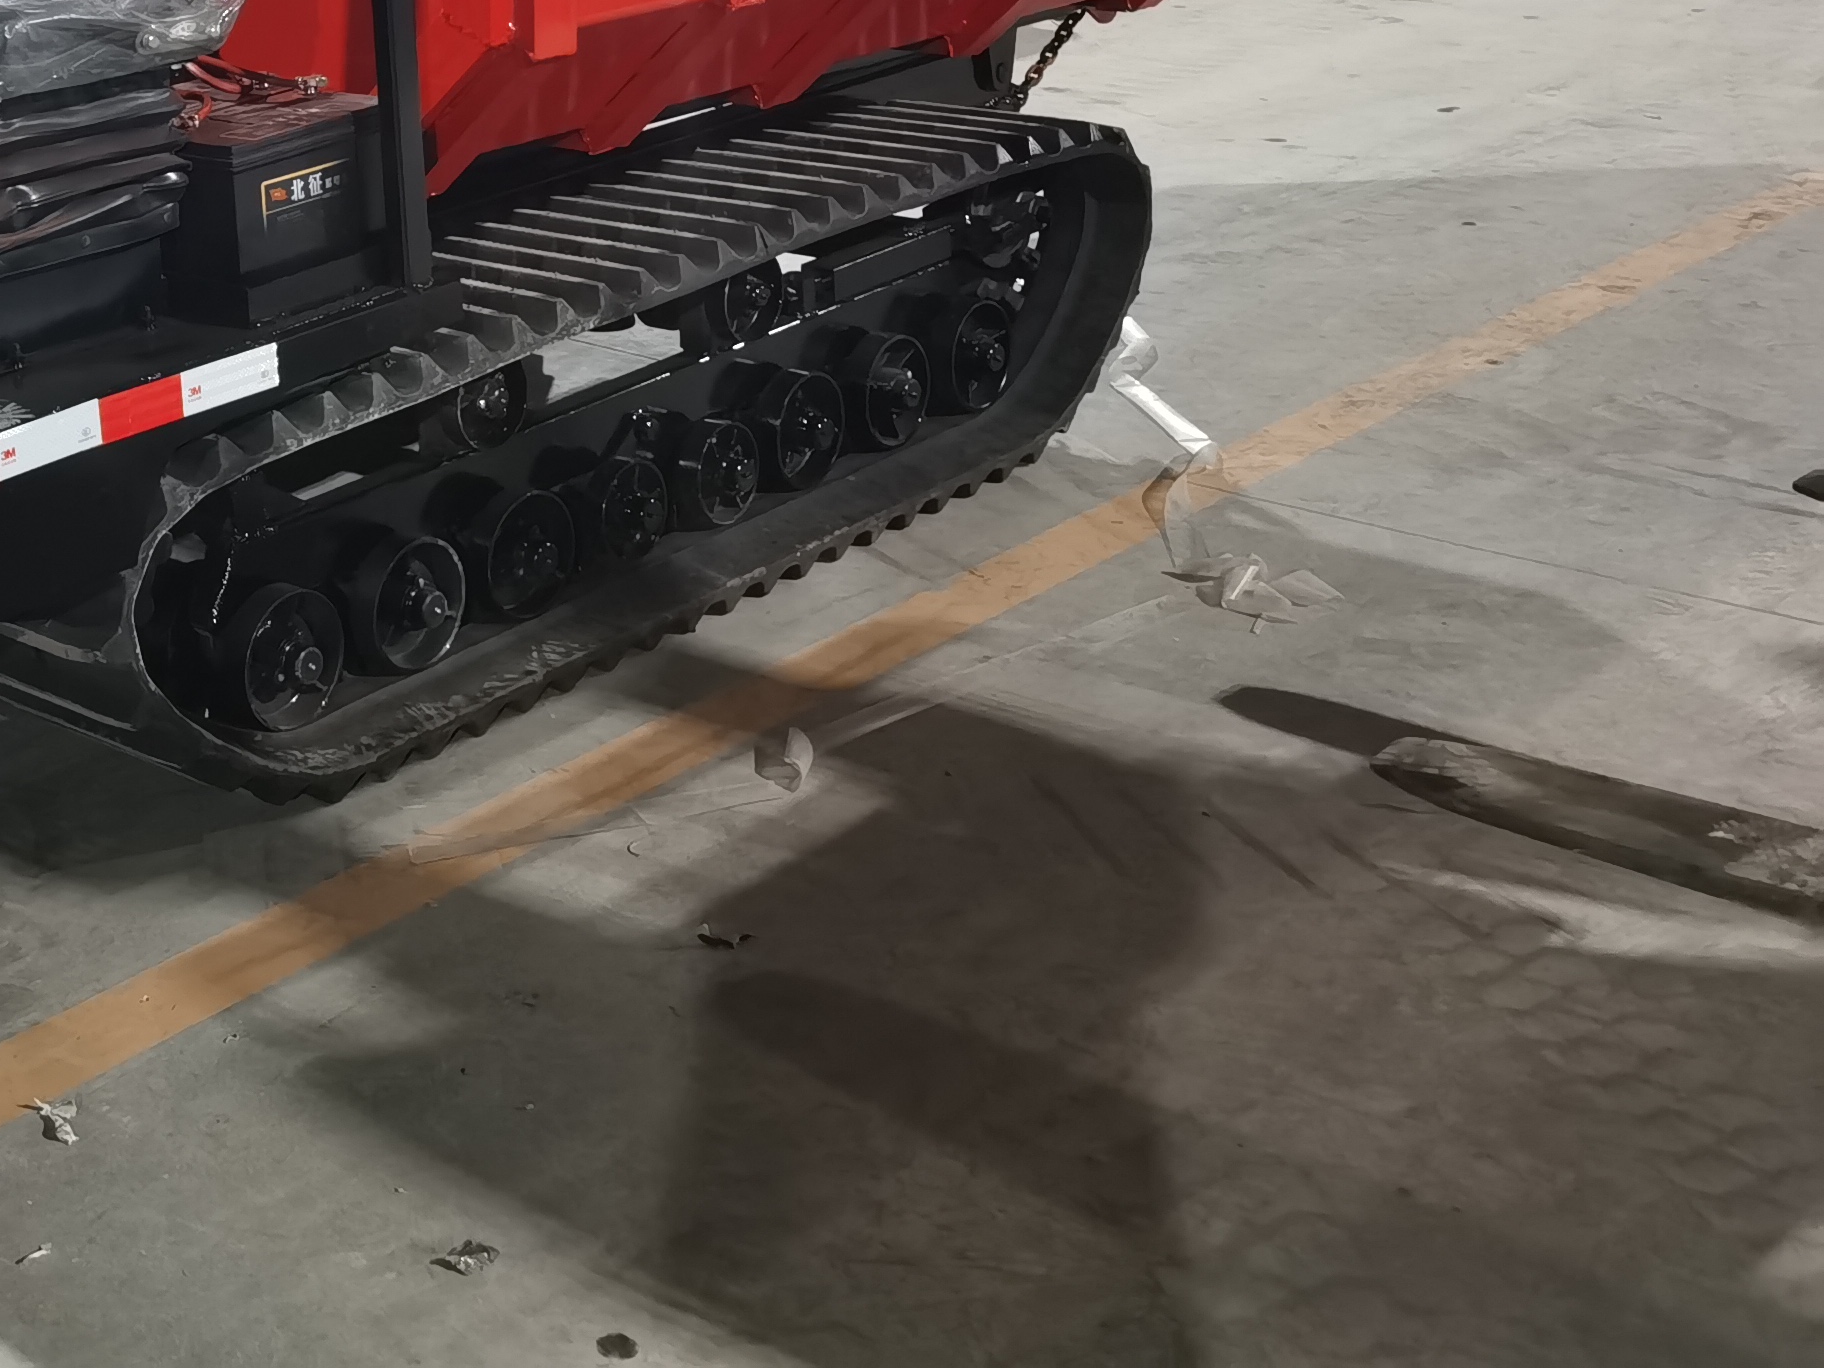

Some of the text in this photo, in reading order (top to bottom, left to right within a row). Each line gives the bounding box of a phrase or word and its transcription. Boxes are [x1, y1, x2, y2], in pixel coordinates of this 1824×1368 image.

[290, 172, 324, 202] 北征
[187, 385, 202, 398] 3M
[0, 447, 17, 462] 3M
